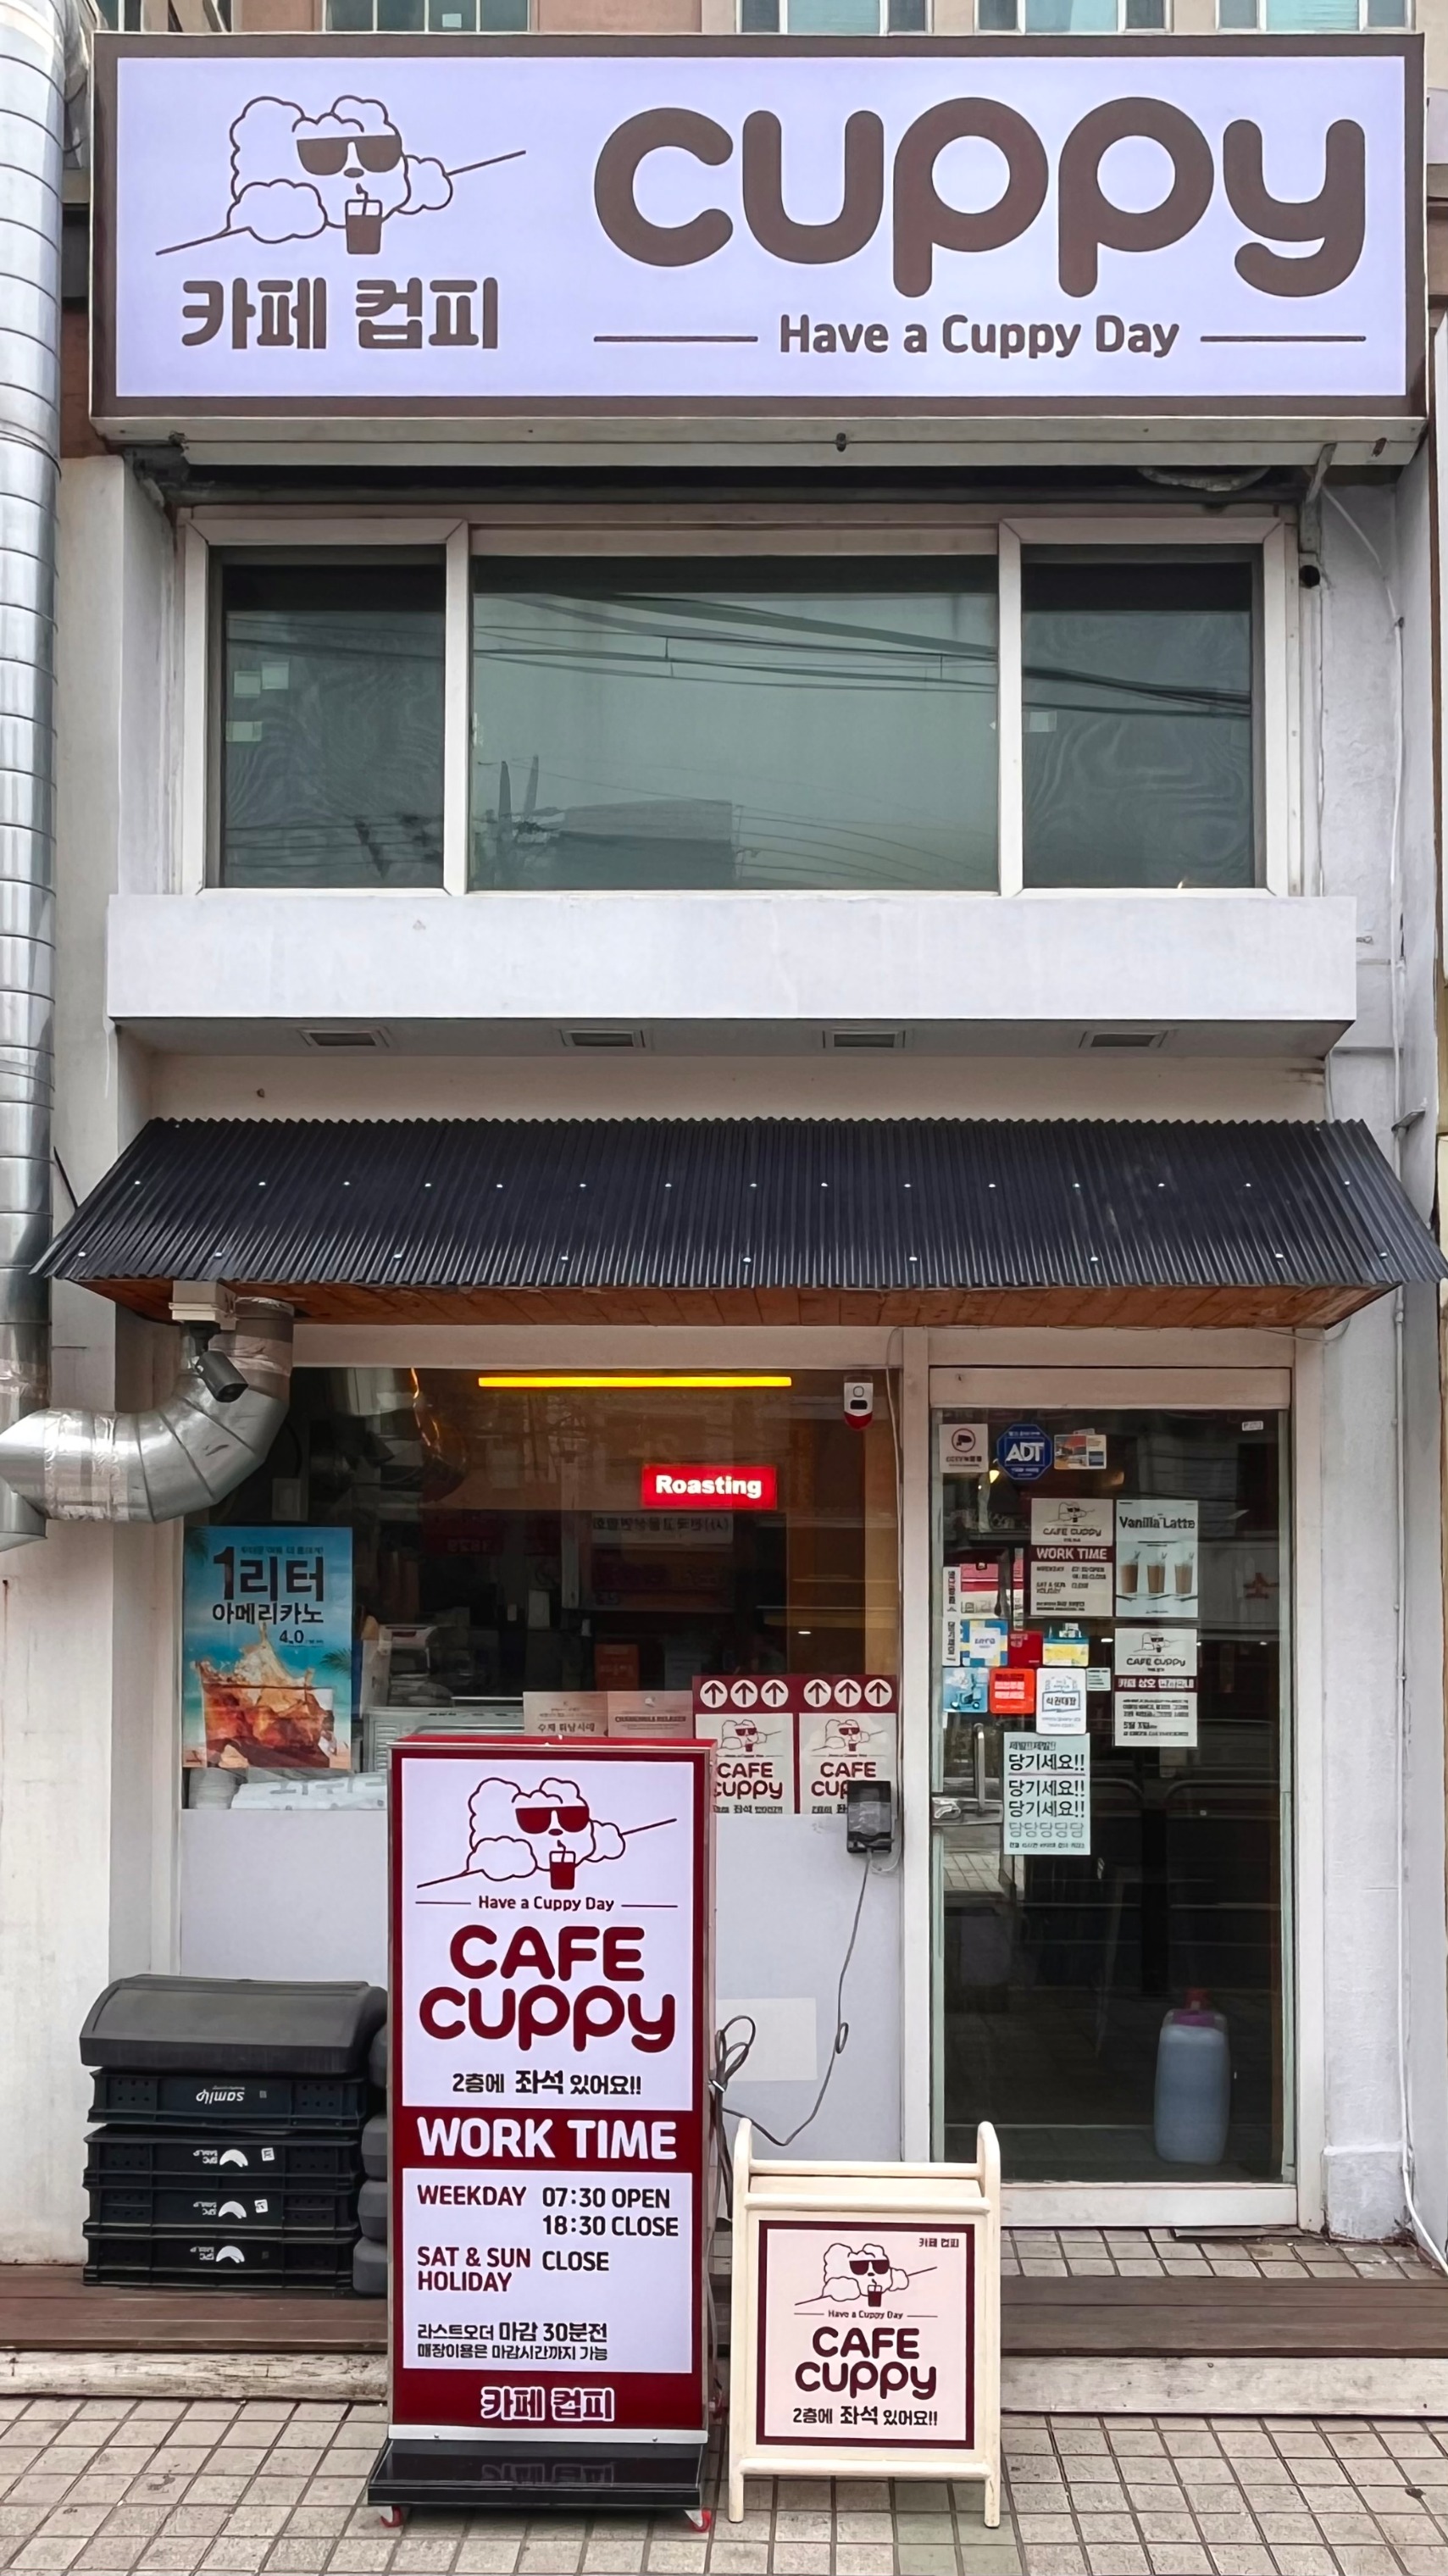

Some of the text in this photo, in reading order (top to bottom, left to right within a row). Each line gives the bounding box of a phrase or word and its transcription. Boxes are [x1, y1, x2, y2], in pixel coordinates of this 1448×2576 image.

[182, 277, 498, 350] 카페 컵피
[780, 314, 1179, 360] Have a Cuppy Day
[1006, 1442, 1045, 1462] ADT
[656, 1474, 762, 1499] Roasting
[1119, 1516, 1196, 1529] Vanilla Latte
[1036, 1547, 1107, 1560] WORK TIME
[214, 1546, 325, 1602] 1리터
[213, 1602, 325, 1625] 아메리카노
[280, 1629, 304, 1645] 4.0
[718, 1762, 774, 1779] CAFE
[820, 1762, 877, 1778] CAFE
[1008, 1753, 1085, 1771] 당기세요!!
[1008, 1779, 1085, 1797] 당기세요!!
[1008, 1800, 1085, 1818] 당기세요!!
[479, 1895, 614, 1912] Have a Cuppy Day
[450, 1924, 645, 1982] CAFE
[452, 2070, 641, 2096] 2층에 좌석 있어요!!
[417, 2117, 677, 2160] WORK TIME
[417, 2185, 670, 2209] WEEKDAY 07:30 OPEN
[542, 2215, 679, 2237] 18:30 CLOSE
[918, 2238, 937, 2248] 카페
[417, 2246, 609, 2272] SAT & SUN CLOSE
[418, 2271, 512, 2292] HOLIDAY
[828, 2310, 849, 2318] Have
[858, 2311, 885, 2319] Cuppy
[887, 2311, 903, 2319] Day
[417, 2322, 607, 2343] 라스트오더 마감 30분전
[812, 2326, 919, 2359] CAFE
[417, 2343, 607, 2361] 매장이용은 마감시간까지 가능
[480, 2386, 615, 2422] 카페 컵피
[793, 2406, 938, 2426] 2층에 좌석 있어요!!
